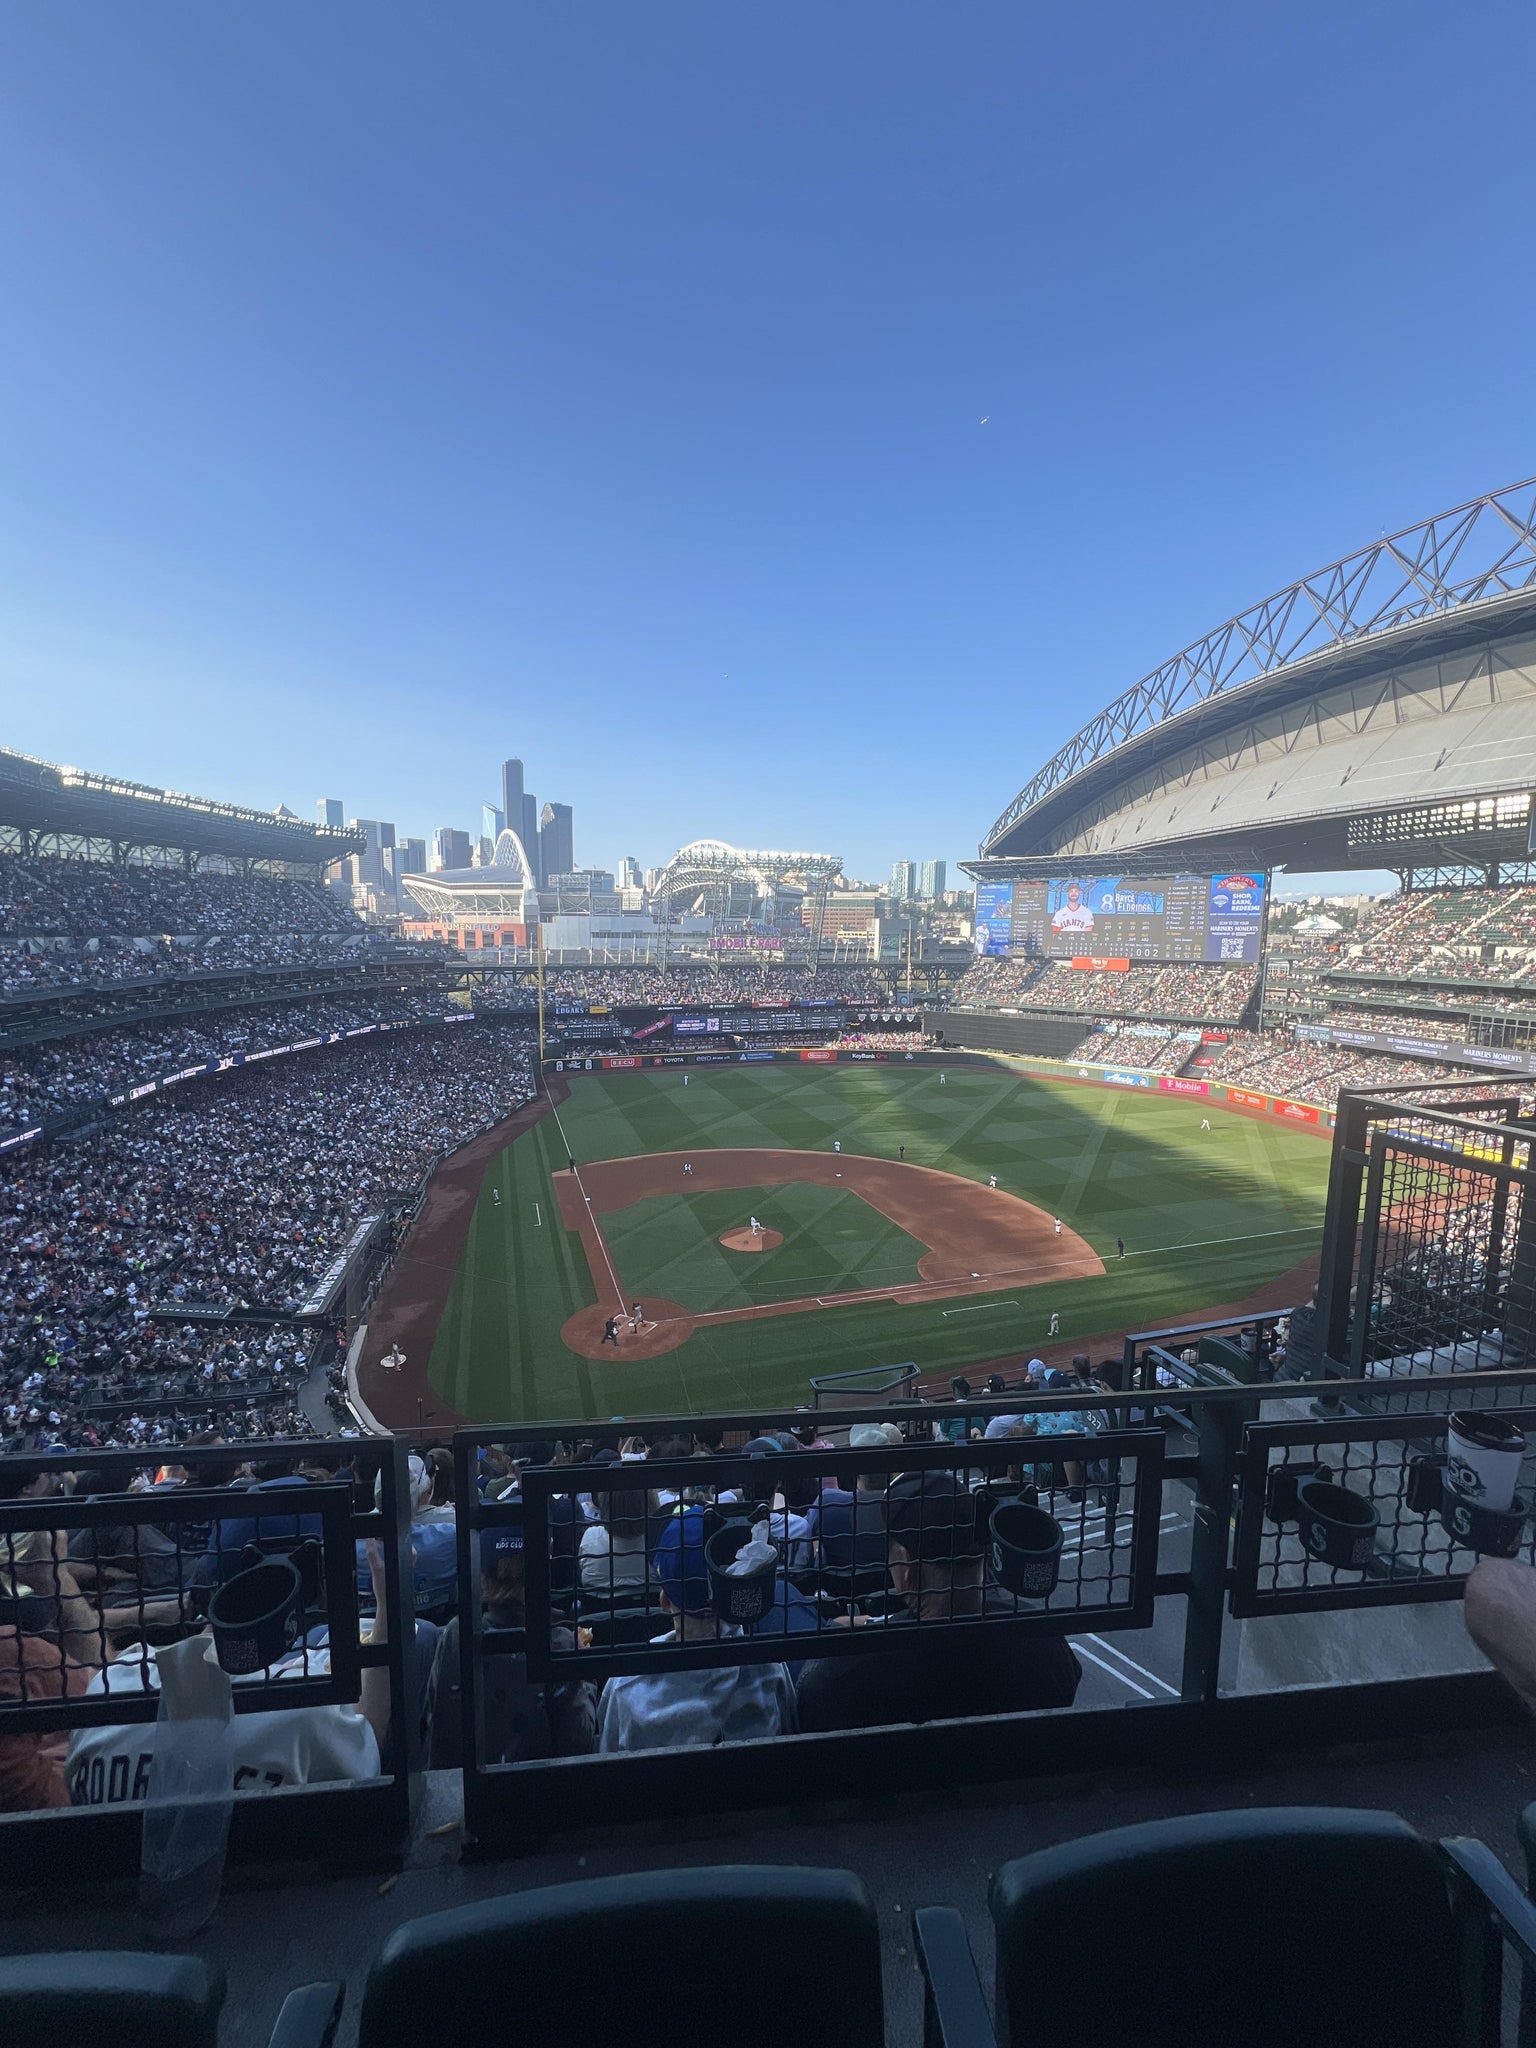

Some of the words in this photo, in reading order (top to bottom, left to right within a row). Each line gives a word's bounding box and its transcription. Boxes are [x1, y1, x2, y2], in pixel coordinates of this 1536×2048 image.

[1100, 894, 1113, 912] 8
[1115, 894, 1134, 903] BRYCE
[1117, 903, 1151, 912] ELDRIDGE
[758, 937, 785, 949] PARK
[1463, 1048, 1492, 1058] MARINERS
[1493, 1052, 1522, 1063] MOMENTS
[1175, 1080, 1202, 1091] Mobile
[1087, 1410, 1102, 1429] 327
[1450, 1459, 1477, 1487] 50
